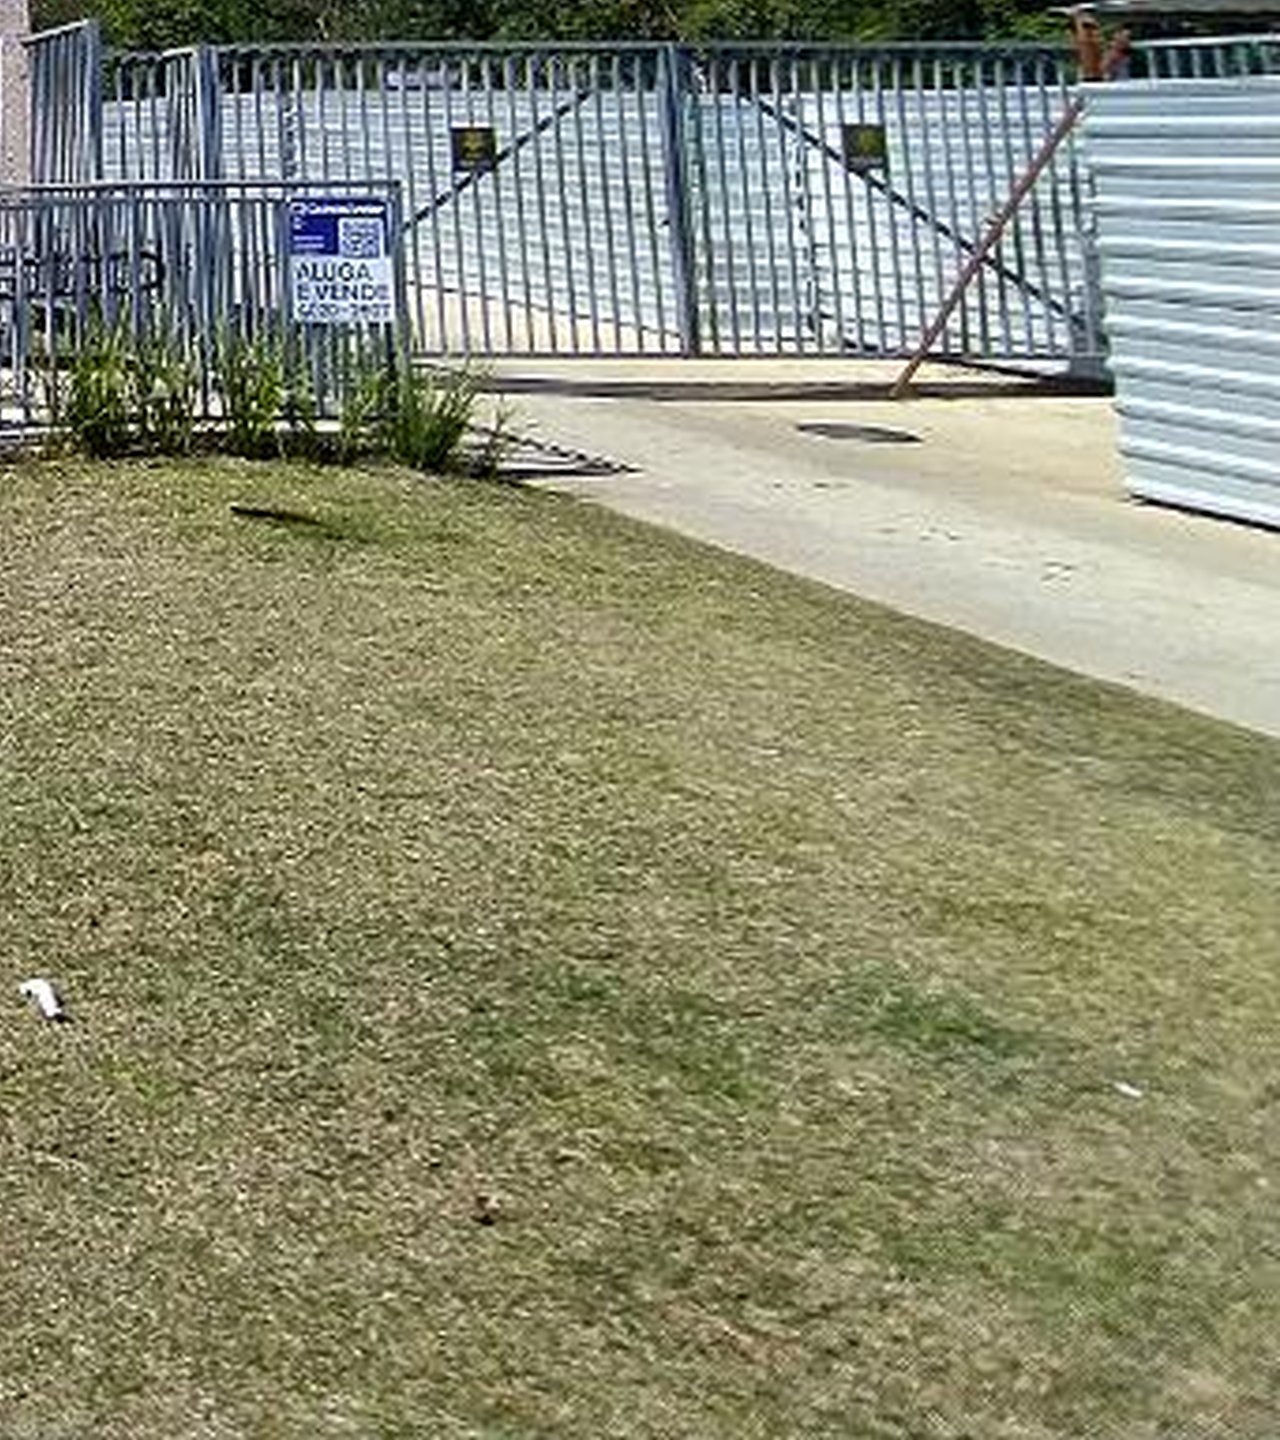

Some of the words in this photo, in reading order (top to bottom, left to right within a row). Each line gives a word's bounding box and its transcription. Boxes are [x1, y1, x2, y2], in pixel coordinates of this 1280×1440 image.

[297, 262, 373, 282] ALUGA
[297, 284, 310, 301] E
[314, 284, 390, 301] VENDE
